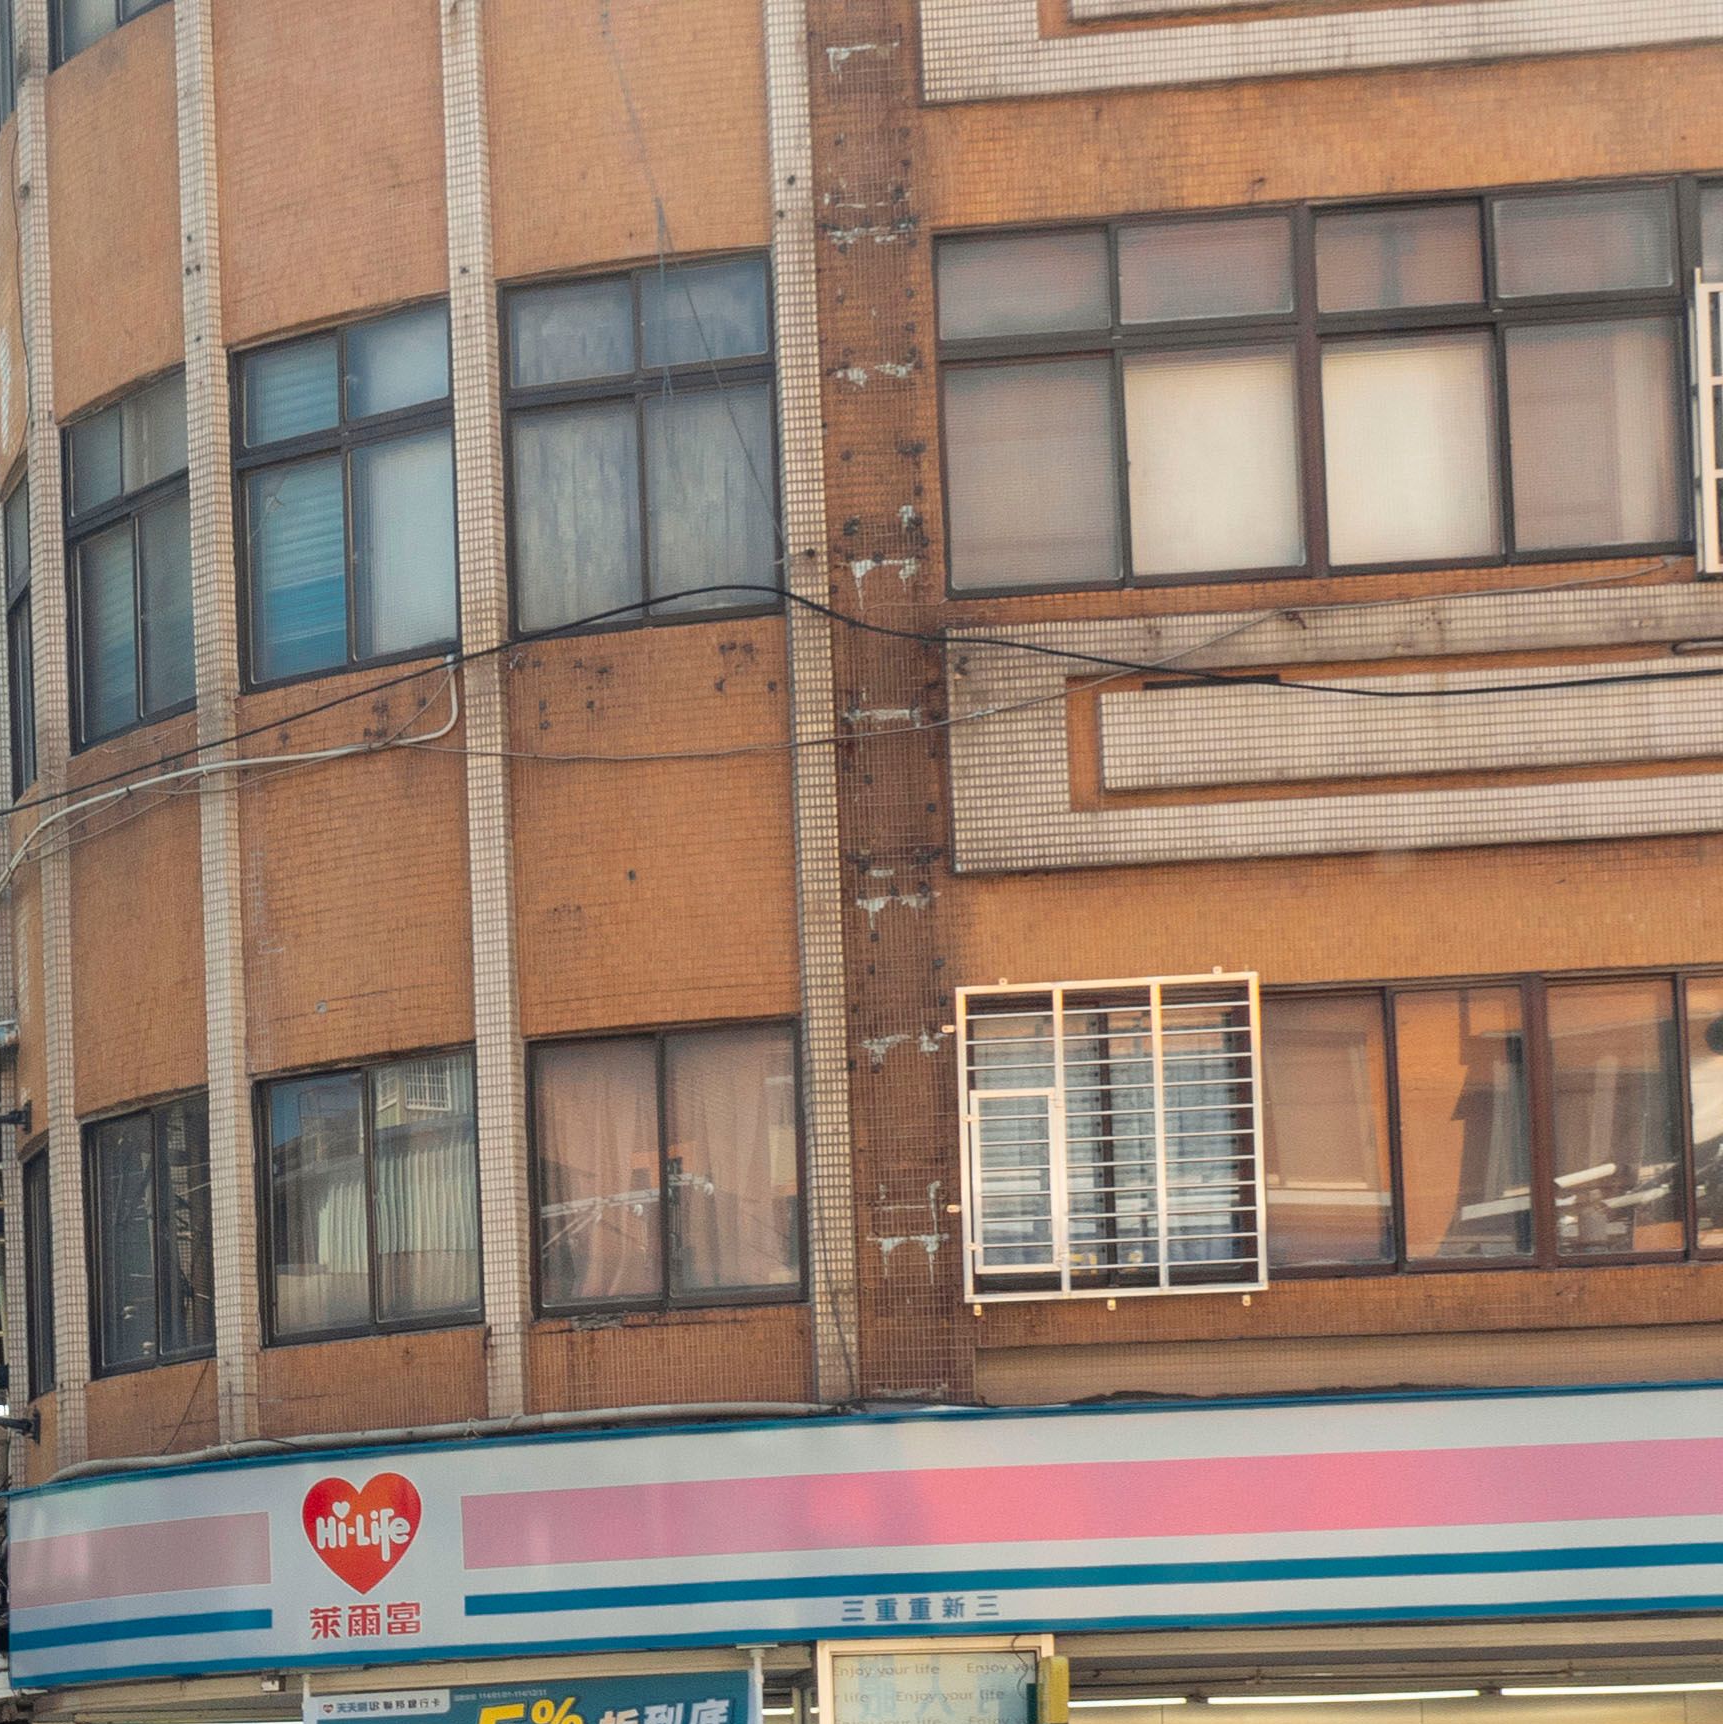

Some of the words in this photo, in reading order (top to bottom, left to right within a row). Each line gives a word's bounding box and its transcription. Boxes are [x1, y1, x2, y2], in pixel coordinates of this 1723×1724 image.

[315, 1501, 412, 1562] Hi-Life
[308, 1601, 423, 1640] 萊爾富
[841, 1595, 999, 1621] 三重重新三
[834, 1665, 872, 1678] Enjoy
[876, 1667, 909, 1678] your
[915, 1664, 940, 1675] life
[966, 1663, 1008, 1675] Enjoy
[896, 1691, 934, 1704] Enjoy
[941, 1692, 973, 1703] your
